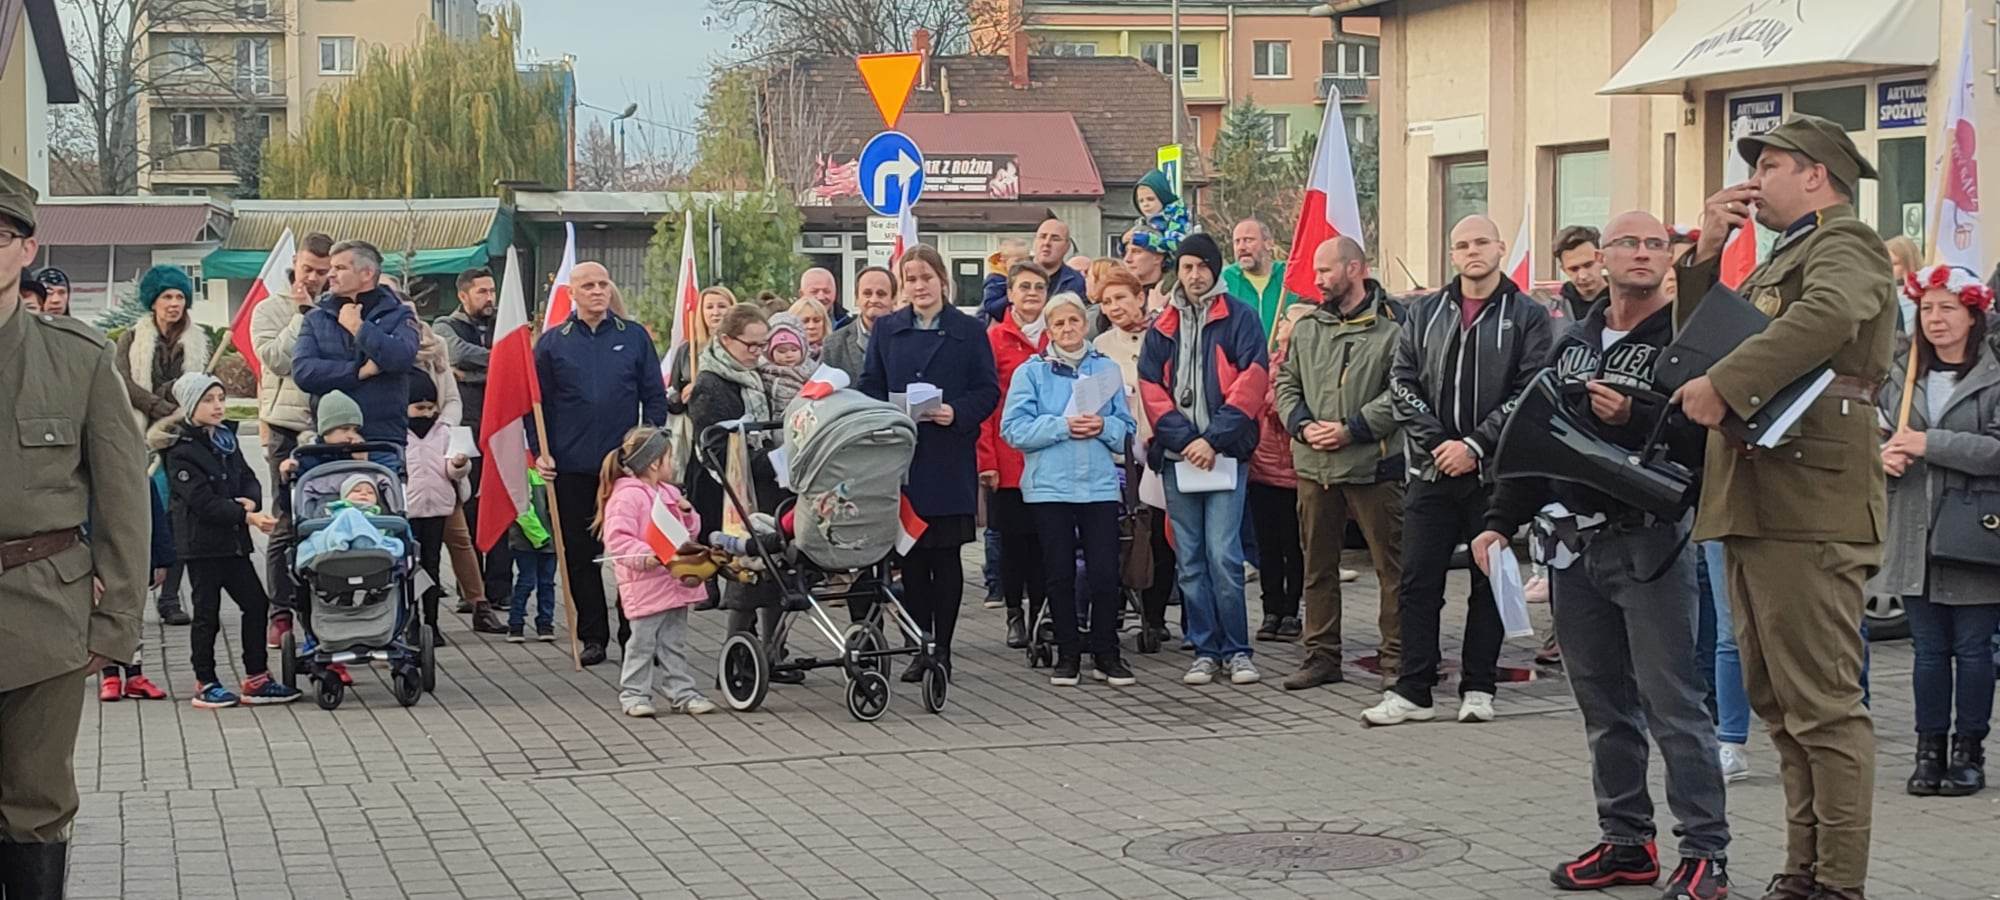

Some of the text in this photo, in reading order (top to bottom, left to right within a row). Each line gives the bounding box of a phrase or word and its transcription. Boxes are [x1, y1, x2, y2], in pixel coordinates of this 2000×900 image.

[1684, 108, 1696, 126] 13
[941, 160, 951, 174] Z
[951, 158, 993, 174] ROŻNA
